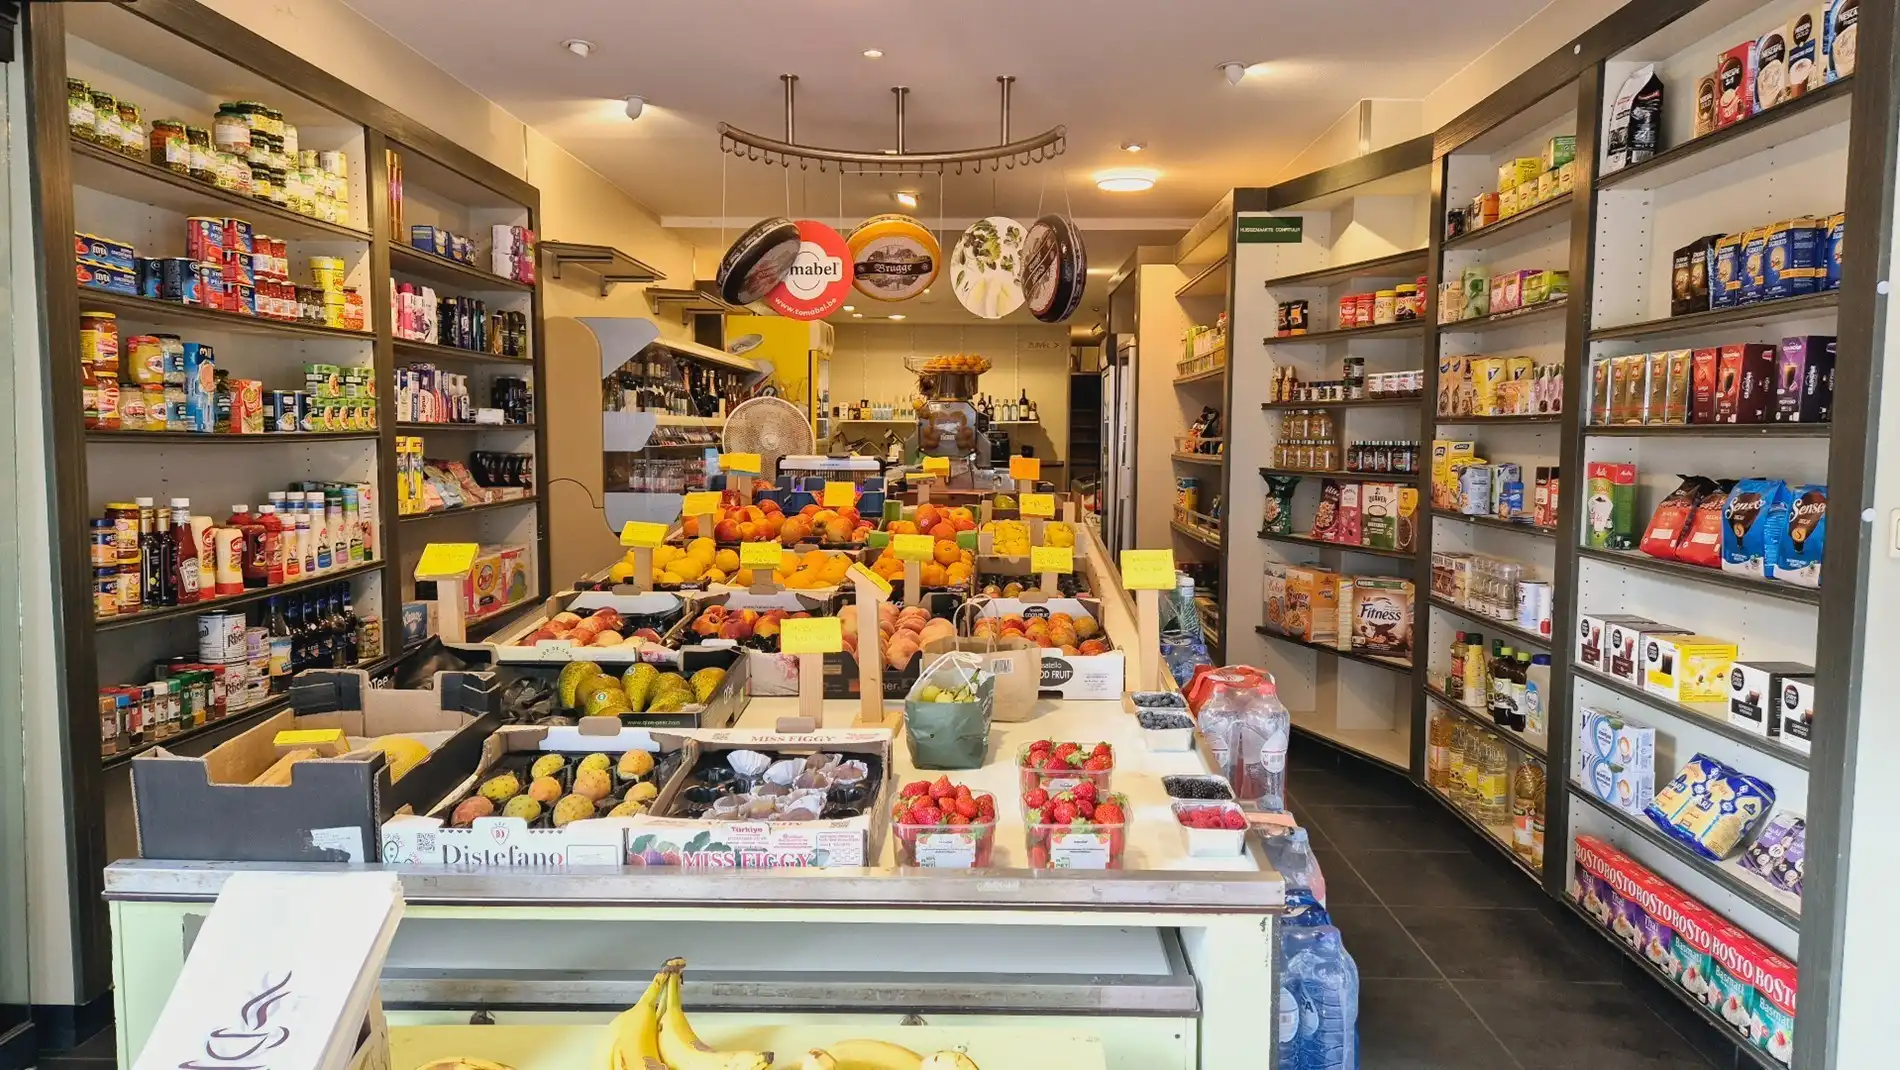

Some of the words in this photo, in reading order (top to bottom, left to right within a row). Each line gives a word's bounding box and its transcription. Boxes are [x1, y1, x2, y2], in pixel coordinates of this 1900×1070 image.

[790, 262, 837, 276] mabel
[874, 263, 913, 273] Brugge
[775, 298, 837, 317] www.tomabel.be
[1725, 496, 1767, 520] Senseo
[1361, 603, 1401, 622] Fitness
[1051, 670, 1071, 679] FRUIT
[751, 735, 786, 743] MISS
[788, 735, 835, 743] FIGGY
[731, 826, 763, 834] Türkiye
[442, 844, 564, 867] Distefano
[681, 851, 736, 867] MISS
[740, 851, 813, 867] FIGGY
[1576, 843, 1604, 873] BOSTO
[1604, 864, 1636, 897] BOSTO
[1611, 891, 1625, 905] Thai
[1636, 885, 1672, 921] BOSTO
[1644, 914, 1659, 931] Thai
[1672, 909, 1710, 948] BOSTO
[1675, 936, 1702, 963] Basmati
[1712, 935, 1753, 979] BOSTO
[1715, 964, 1745, 994] Basmati
